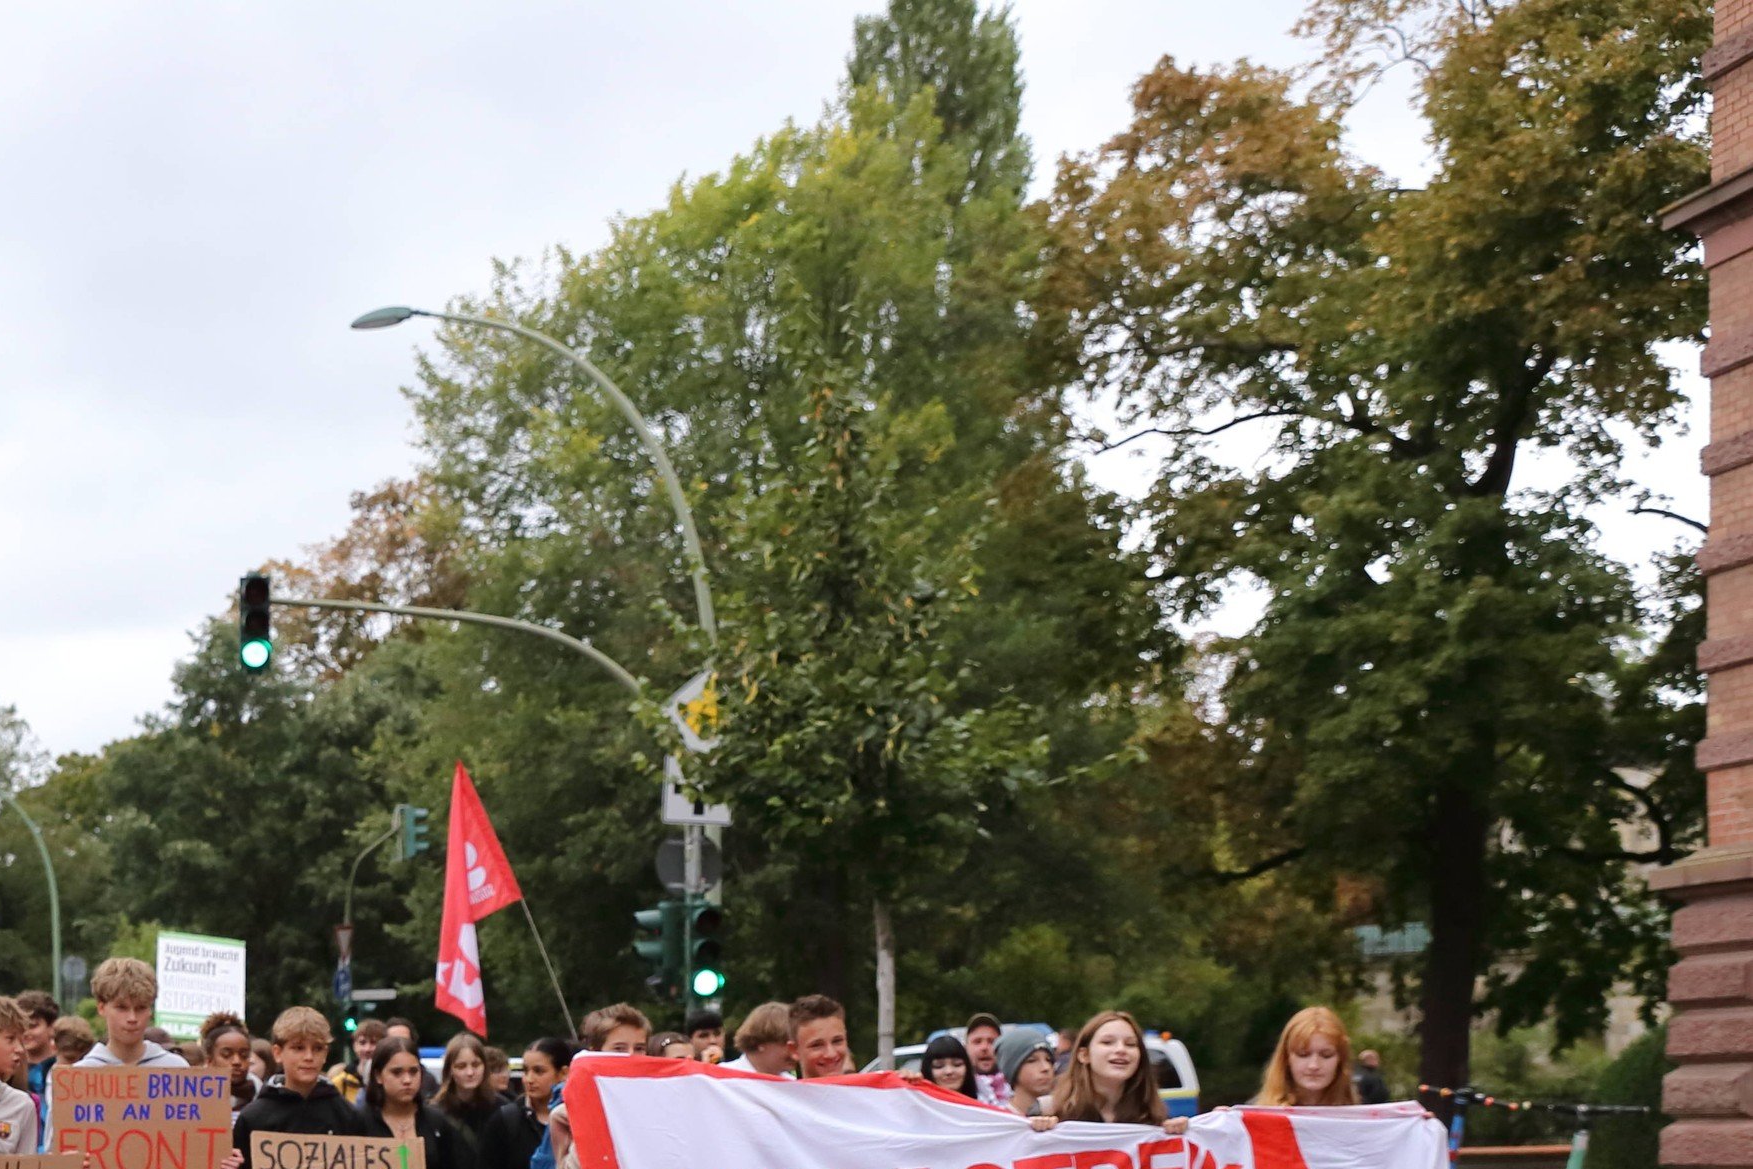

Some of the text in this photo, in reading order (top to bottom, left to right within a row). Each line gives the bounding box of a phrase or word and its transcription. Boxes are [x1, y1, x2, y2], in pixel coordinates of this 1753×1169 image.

[163, 956, 217, 975] Zukunft
[56, 1070, 228, 1100] SCHULE BRINGT
[74, 1104, 201, 1122] DIR AN DER
